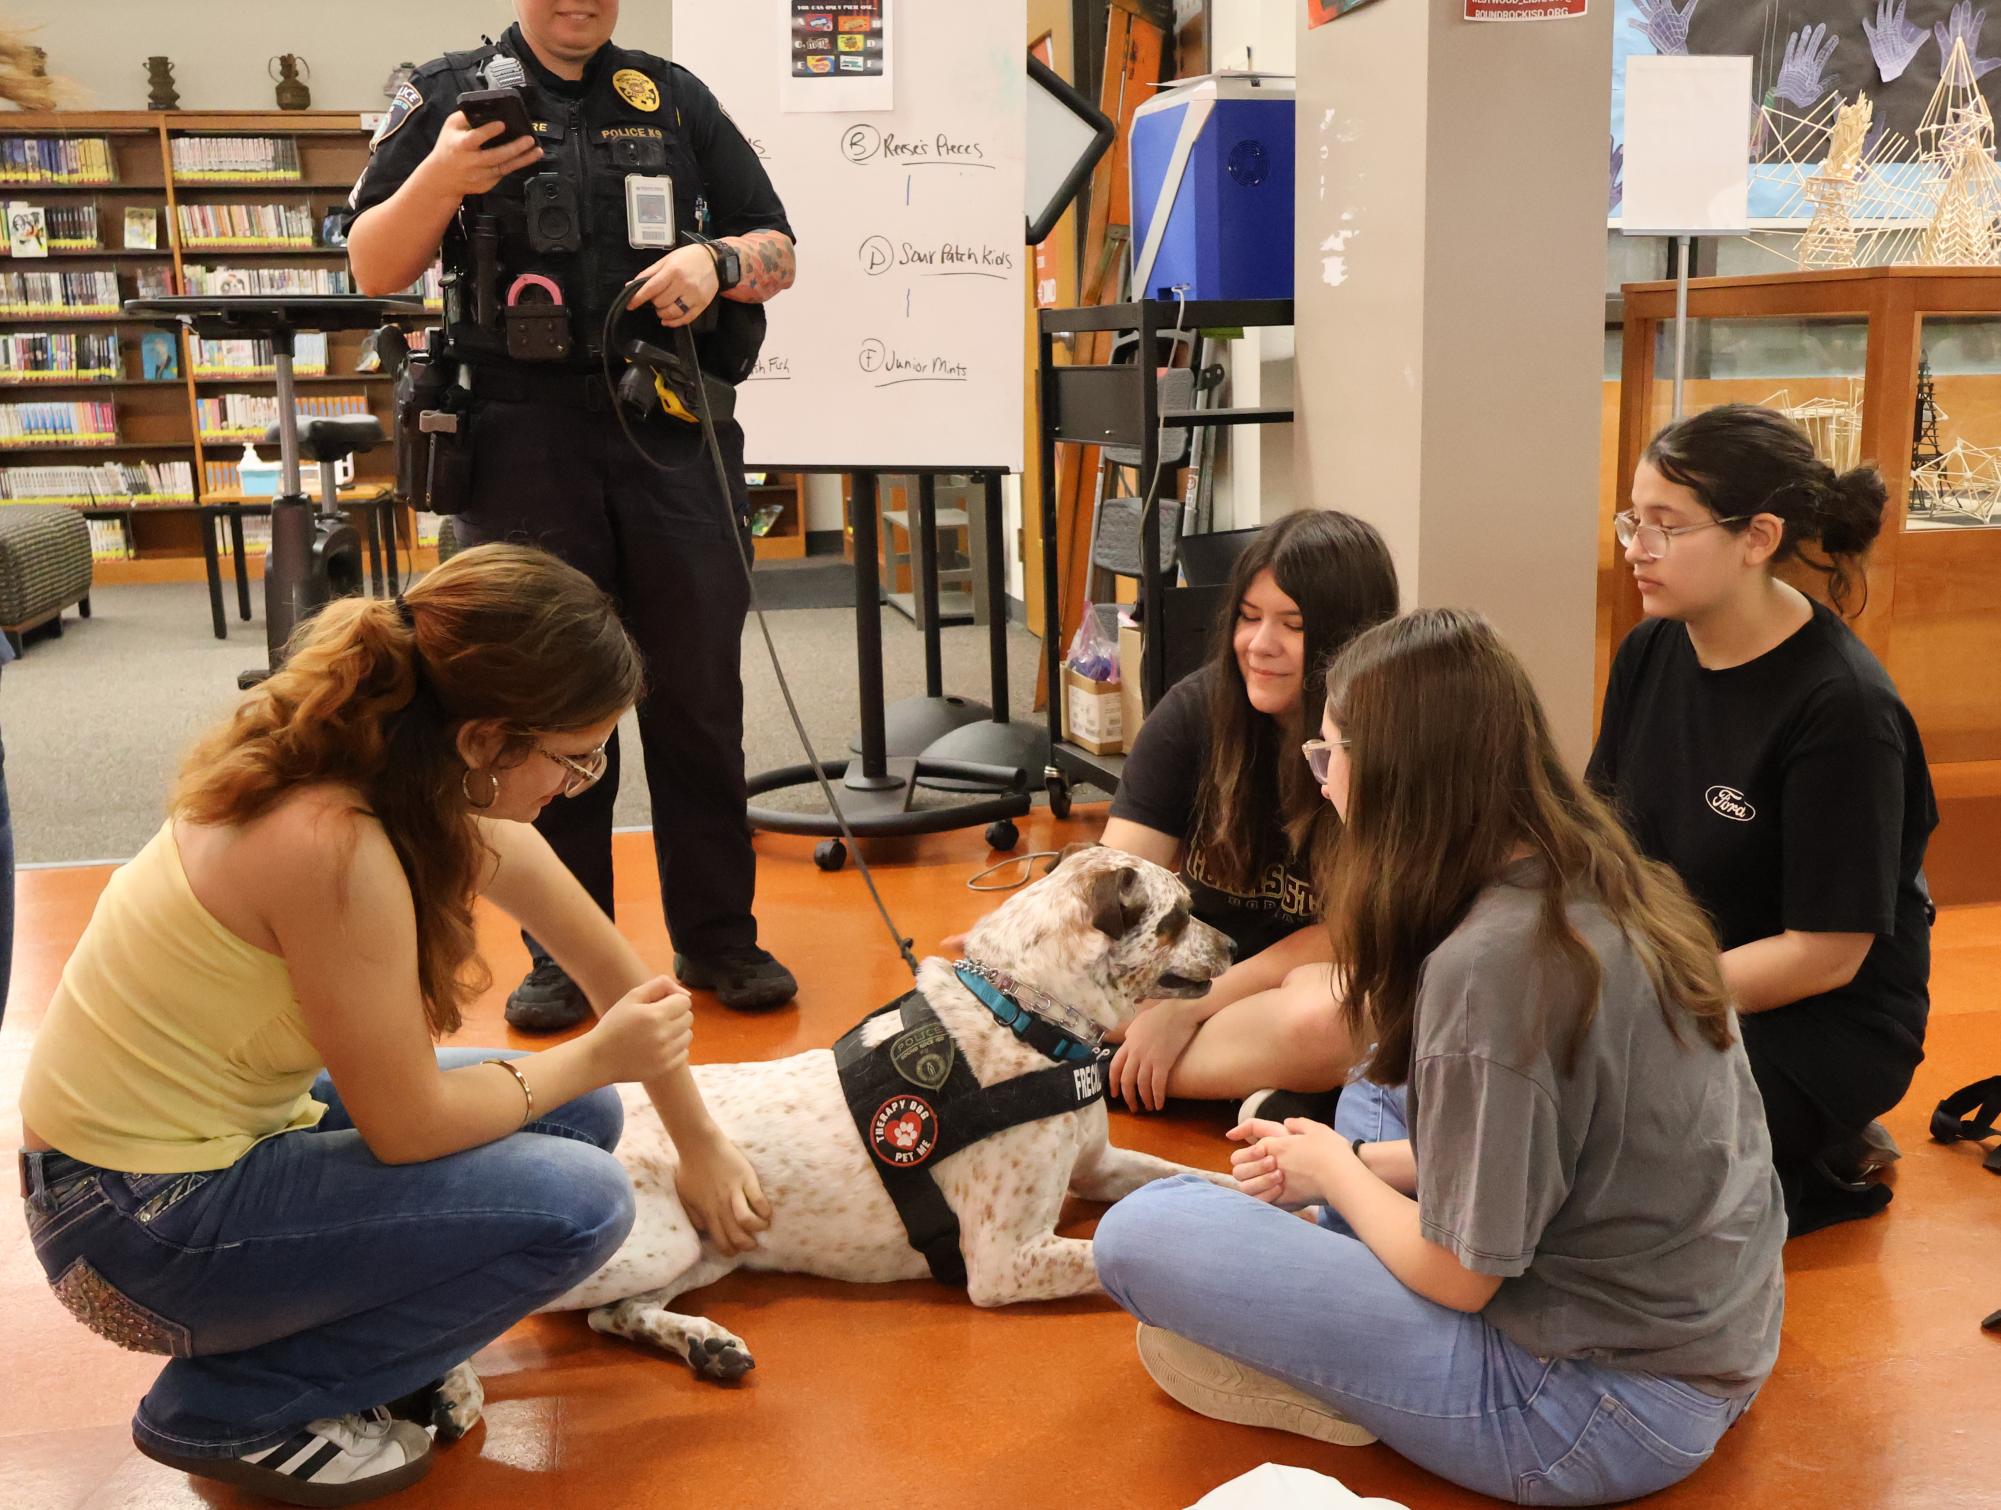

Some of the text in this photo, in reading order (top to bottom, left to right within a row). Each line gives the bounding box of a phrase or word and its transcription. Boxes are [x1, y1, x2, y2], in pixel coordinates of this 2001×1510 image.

[601, 127, 646, 139] POLICE
[883, 132, 929, 159] Reese's
[899, 242, 936, 265] Sour
[940, 243, 978, 268] Patch
[982, 244, 1013, 269] Kids
[885, 349, 928, 372] Junior
[932, 356, 967, 377] Mints
[1712, 789, 1747, 818] Ford
[897, 1026, 945, 1053] POLICE
[875, 1099, 930, 1143] THERAPY DOG
[895, 1139, 931, 1162] PET ME
